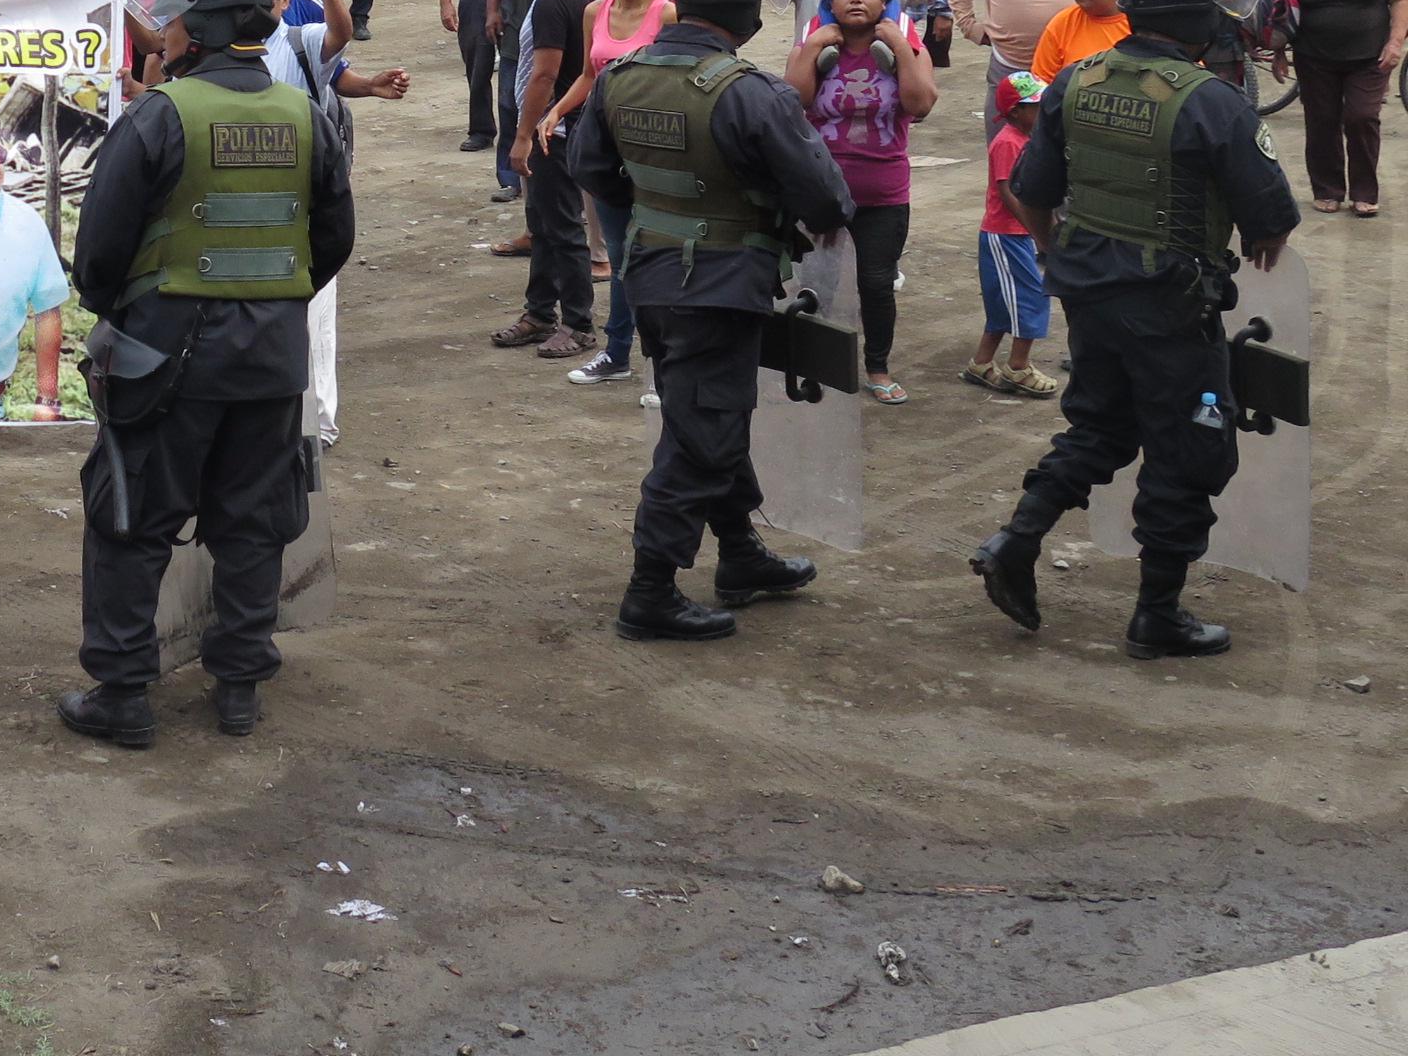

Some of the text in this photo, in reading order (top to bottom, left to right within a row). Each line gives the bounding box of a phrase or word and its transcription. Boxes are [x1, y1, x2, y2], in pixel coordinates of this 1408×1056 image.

[76, 28, 104, 71] ?
[1077, 90, 1151, 120] POLICIA
[619, 111, 680, 132] POLICIA
[216, 127, 294, 152] POLICIA
[256, 152, 295, 162] ESPECIALES
